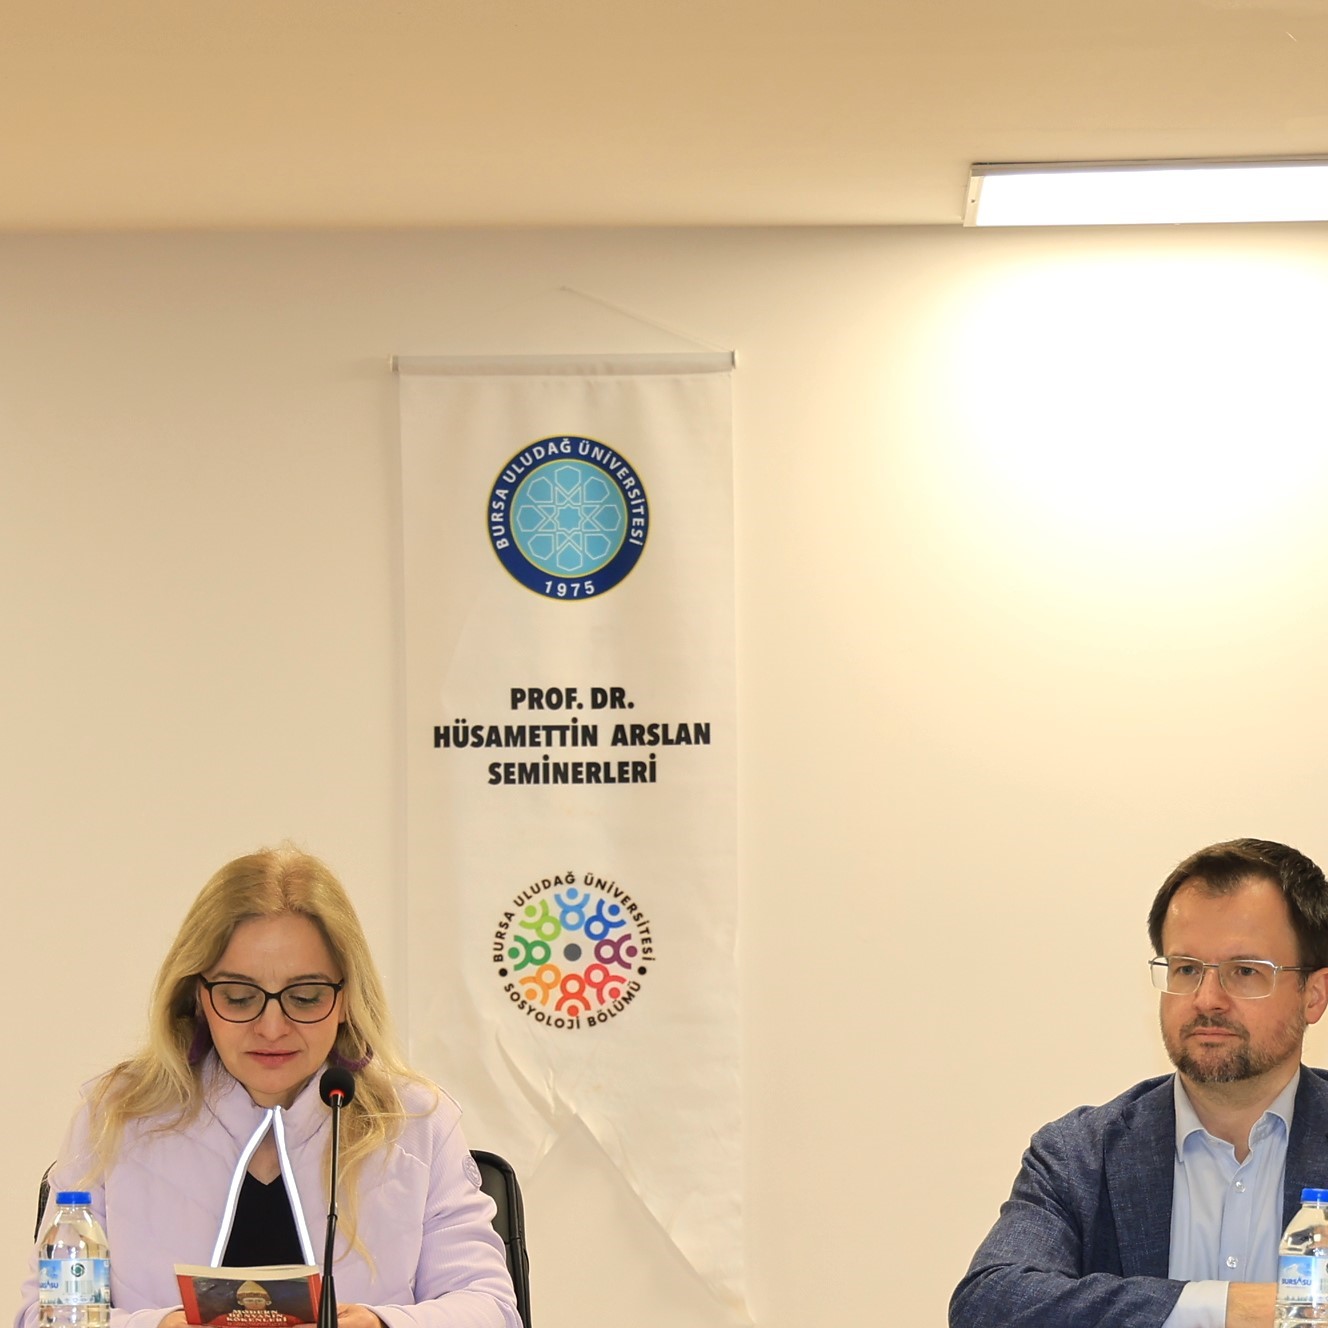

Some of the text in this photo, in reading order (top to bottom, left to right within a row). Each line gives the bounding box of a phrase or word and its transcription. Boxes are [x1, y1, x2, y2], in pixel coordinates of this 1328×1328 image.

[491, 438, 644, 550] BURSA ULUDAĞ ÜNİVERSİTESİ
[544, 581, 596, 597] 1975
[510, 687, 635, 710] PROF. DR.
[433, 717, 711, 748] HÜSAMETTİN ARSLAN
[488, 753, 657, 785] SEMİNERLERİ
[493, 871, 655, 962] BURSA ULUDAĞ ÜNİVERSİTESİ
[504, 980, 641, 1029] SOSYOLOJİ BÖLÜMÜ
